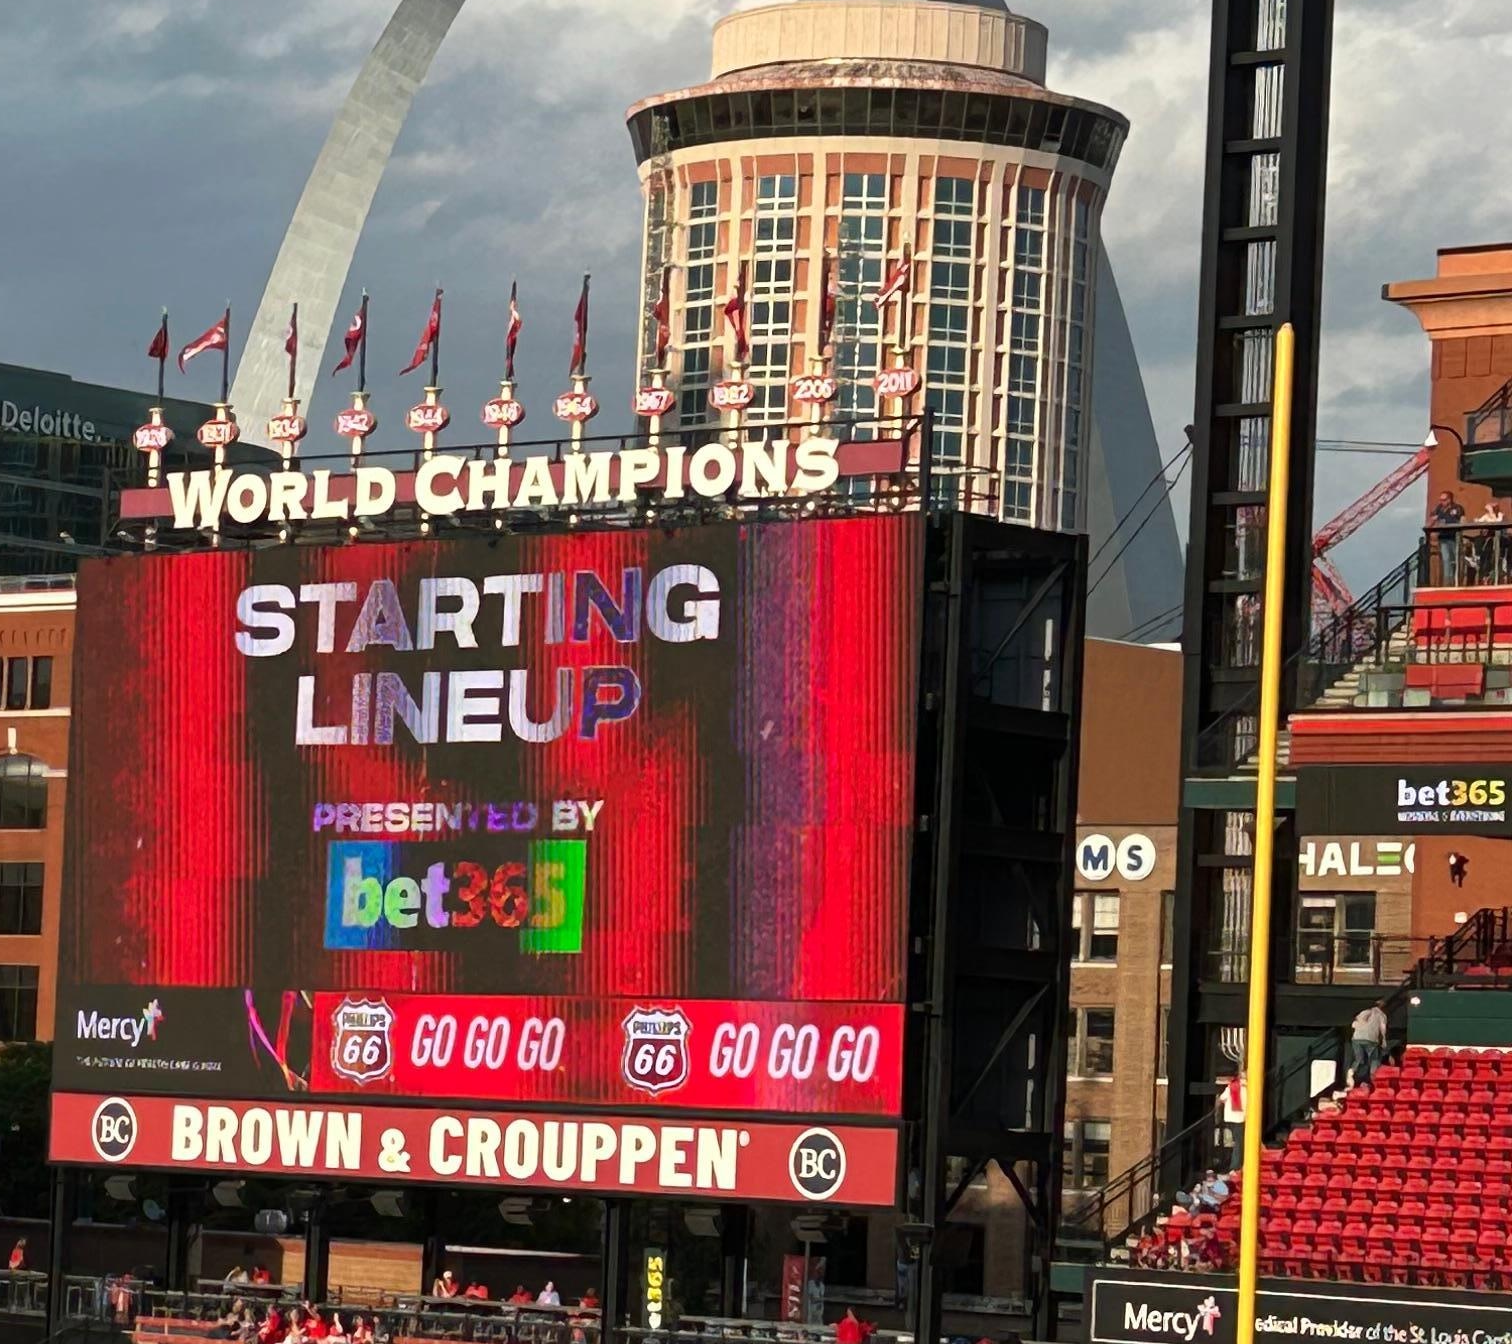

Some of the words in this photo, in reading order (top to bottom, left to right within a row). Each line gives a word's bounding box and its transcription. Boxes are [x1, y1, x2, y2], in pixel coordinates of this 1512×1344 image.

[877, 370, 914, 395] 2011
[166, 467, 396, 530] WORLD
[414, 436, 840, 517] CHAMPIONS
[233, 563, 722, 658] STARTING
[294, 664, 642, 747] LINEUP
[1397, 778, 1507, 807] bet365
[312, 801, 538, 834] PRESENTED
[551, 799, 606, 833] BY
[1081, 844, 1110, 871] M
[1125, 844, 1146, 872] S
[340, 855, 567, 929] bet365
[76, 1008, 145, 1048] Mercy
[410, 1013, 454, 1068] GO
[463, 1015, 511, 1070] GO
[516, 1017, 566, 1072] GO
[342, 1034, 382, 1066] 66
[634, 1048, 676, 1076] 66
[709, 1021, 758, 1079] GO
[767, 1023, 818, 1082] GO
[826, 1025, 881, 1084] GO
[99, 1114, 130, 1145] BC
[171, 1104, 364, 1170] BROWN
[377, 1127, 411, 1174] &
[428, 1115, 744, 1191] CROUPPEN
[799, 1149, 838, 1181] BC
[1123, 1302, 1199, 1342] Mercy
[1254, 1316, 1299, 1334] edical
[1384, 1322, 1408, 1343] the
